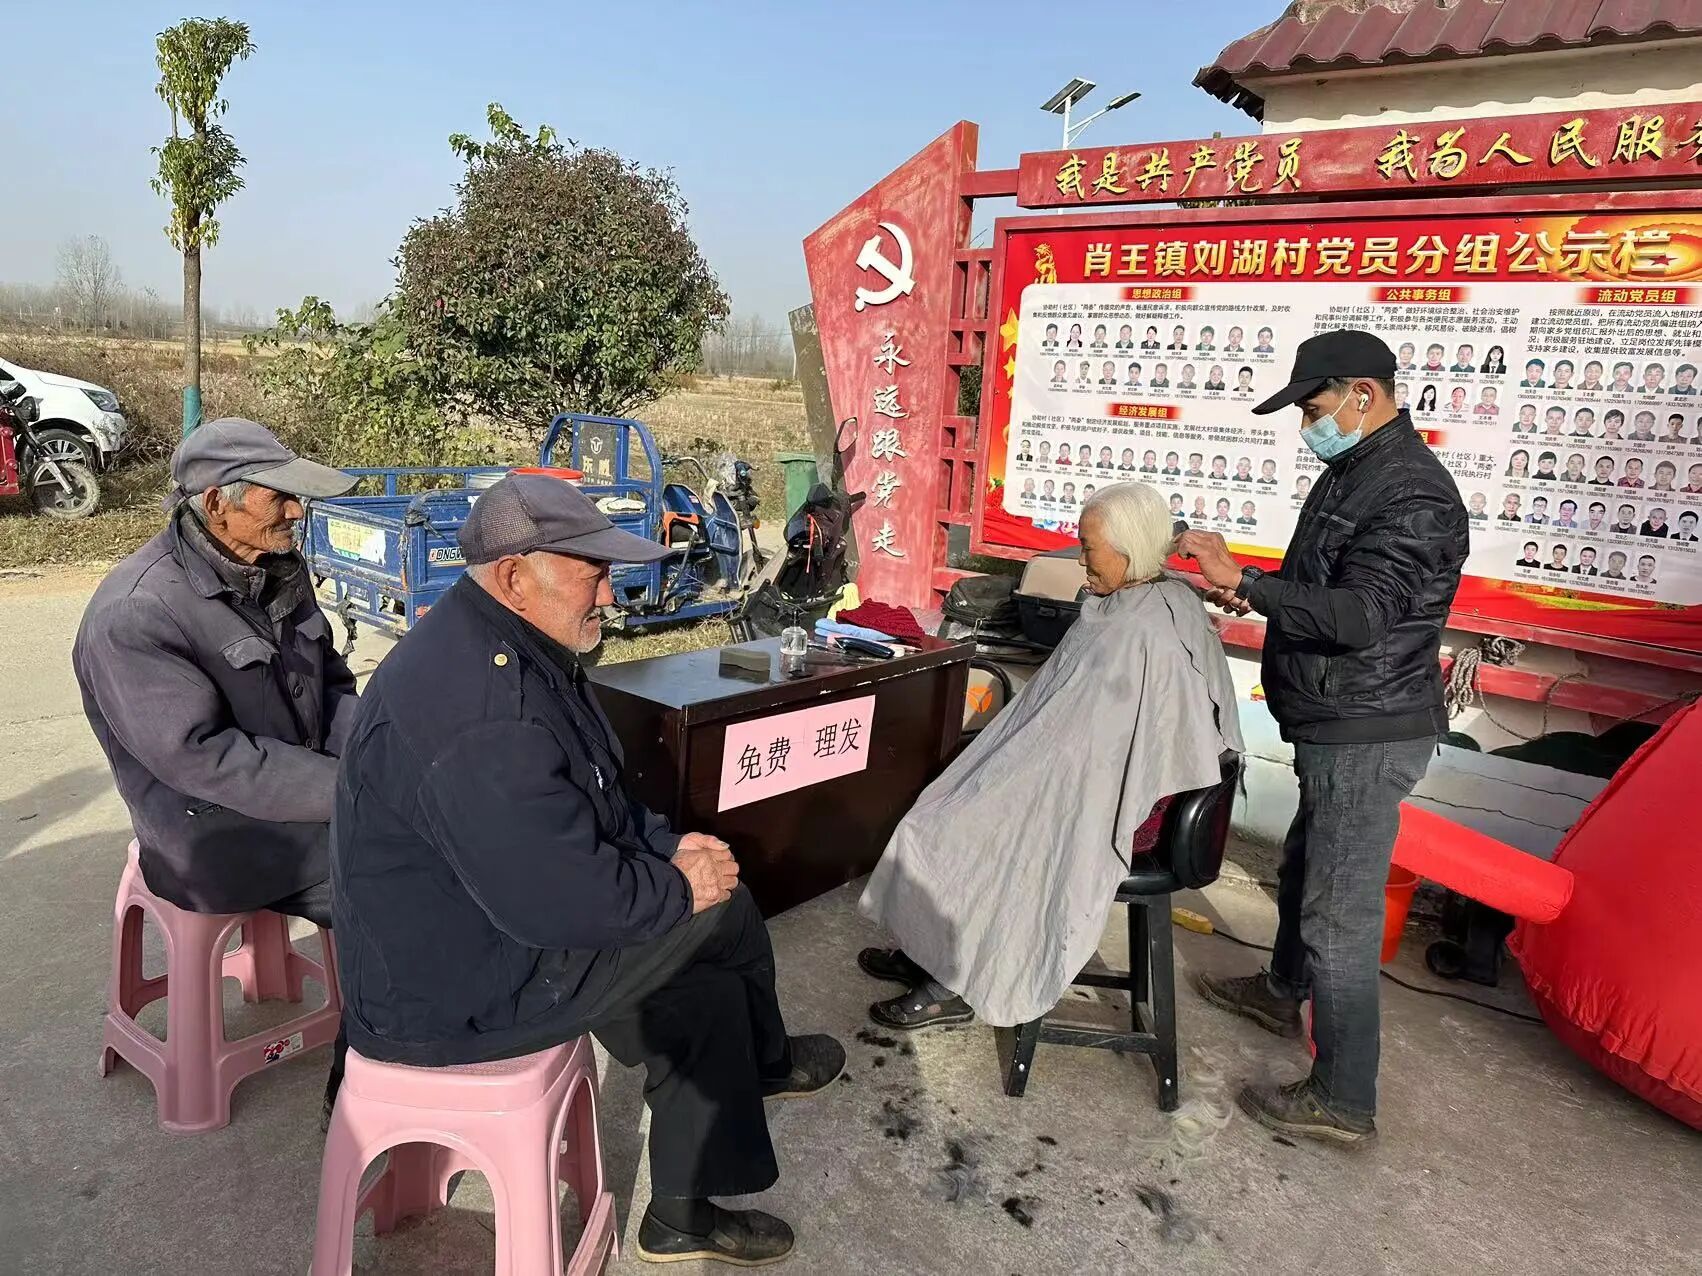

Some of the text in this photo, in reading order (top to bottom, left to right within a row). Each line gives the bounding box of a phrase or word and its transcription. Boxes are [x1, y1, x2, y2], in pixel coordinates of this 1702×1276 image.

[1055, 138, 1303, 200] 我是共产党员
[1084, 230, 1671, 277] 肖王镇刘湖村党员分组公示栏
[1131, 287, 1182, 299] 思想政治组
[1386, 288, 1451, 301] 公共事务组
[1597, 289, 1677, 304] 流动党员组
[1118, 405, 1168, 418] 经济发展组
[871, 335, 912, 557] 永远跟党走
[734, 718, 862, 785] 免费 理发
